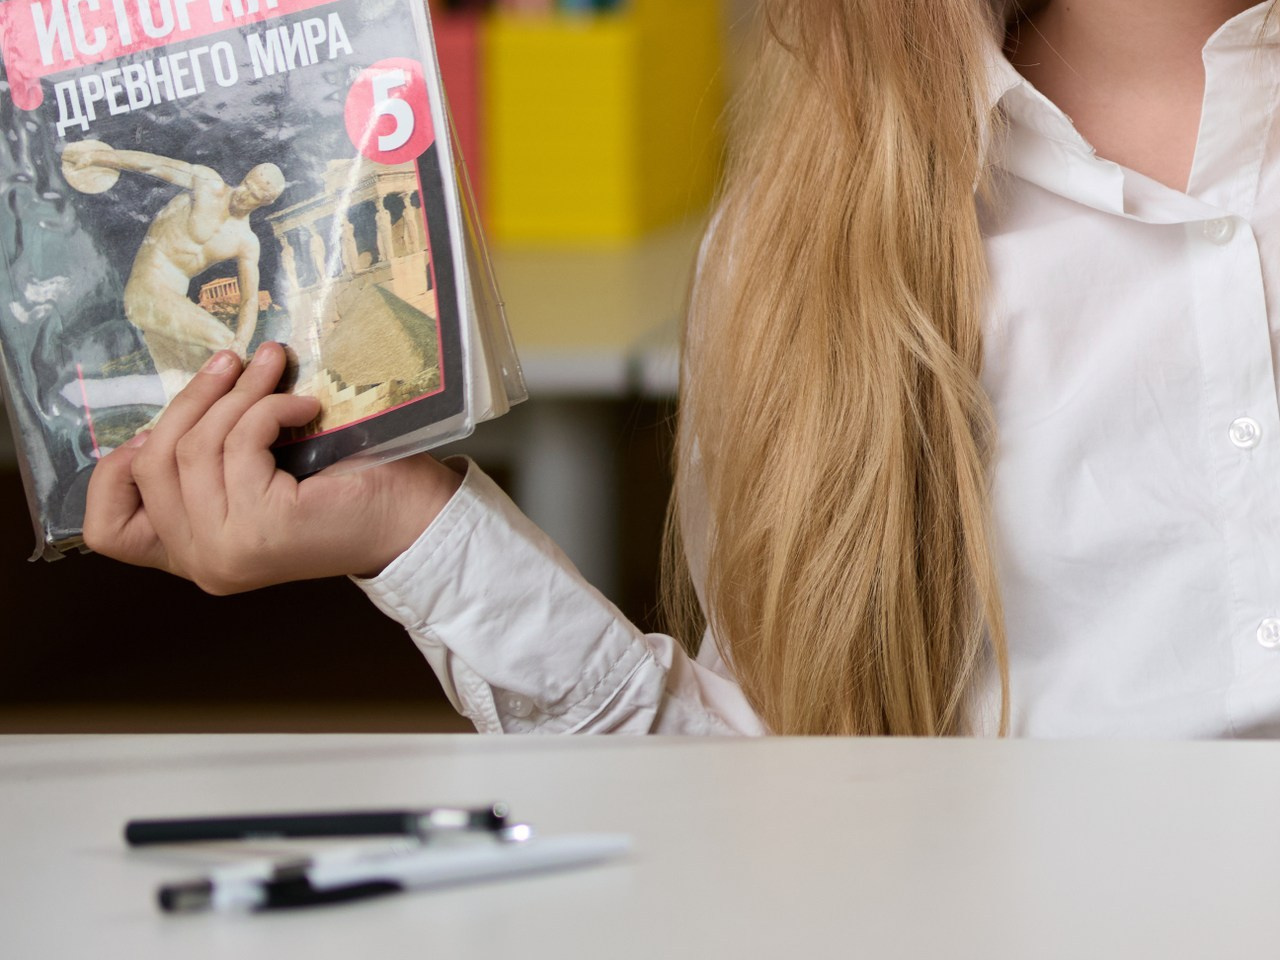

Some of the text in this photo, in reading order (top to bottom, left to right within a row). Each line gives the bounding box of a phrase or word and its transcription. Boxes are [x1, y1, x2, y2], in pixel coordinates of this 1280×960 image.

[54, 12, 353, 137] ДРЕВНЕГО МИРА
[371, 69, 415, 152] 5
